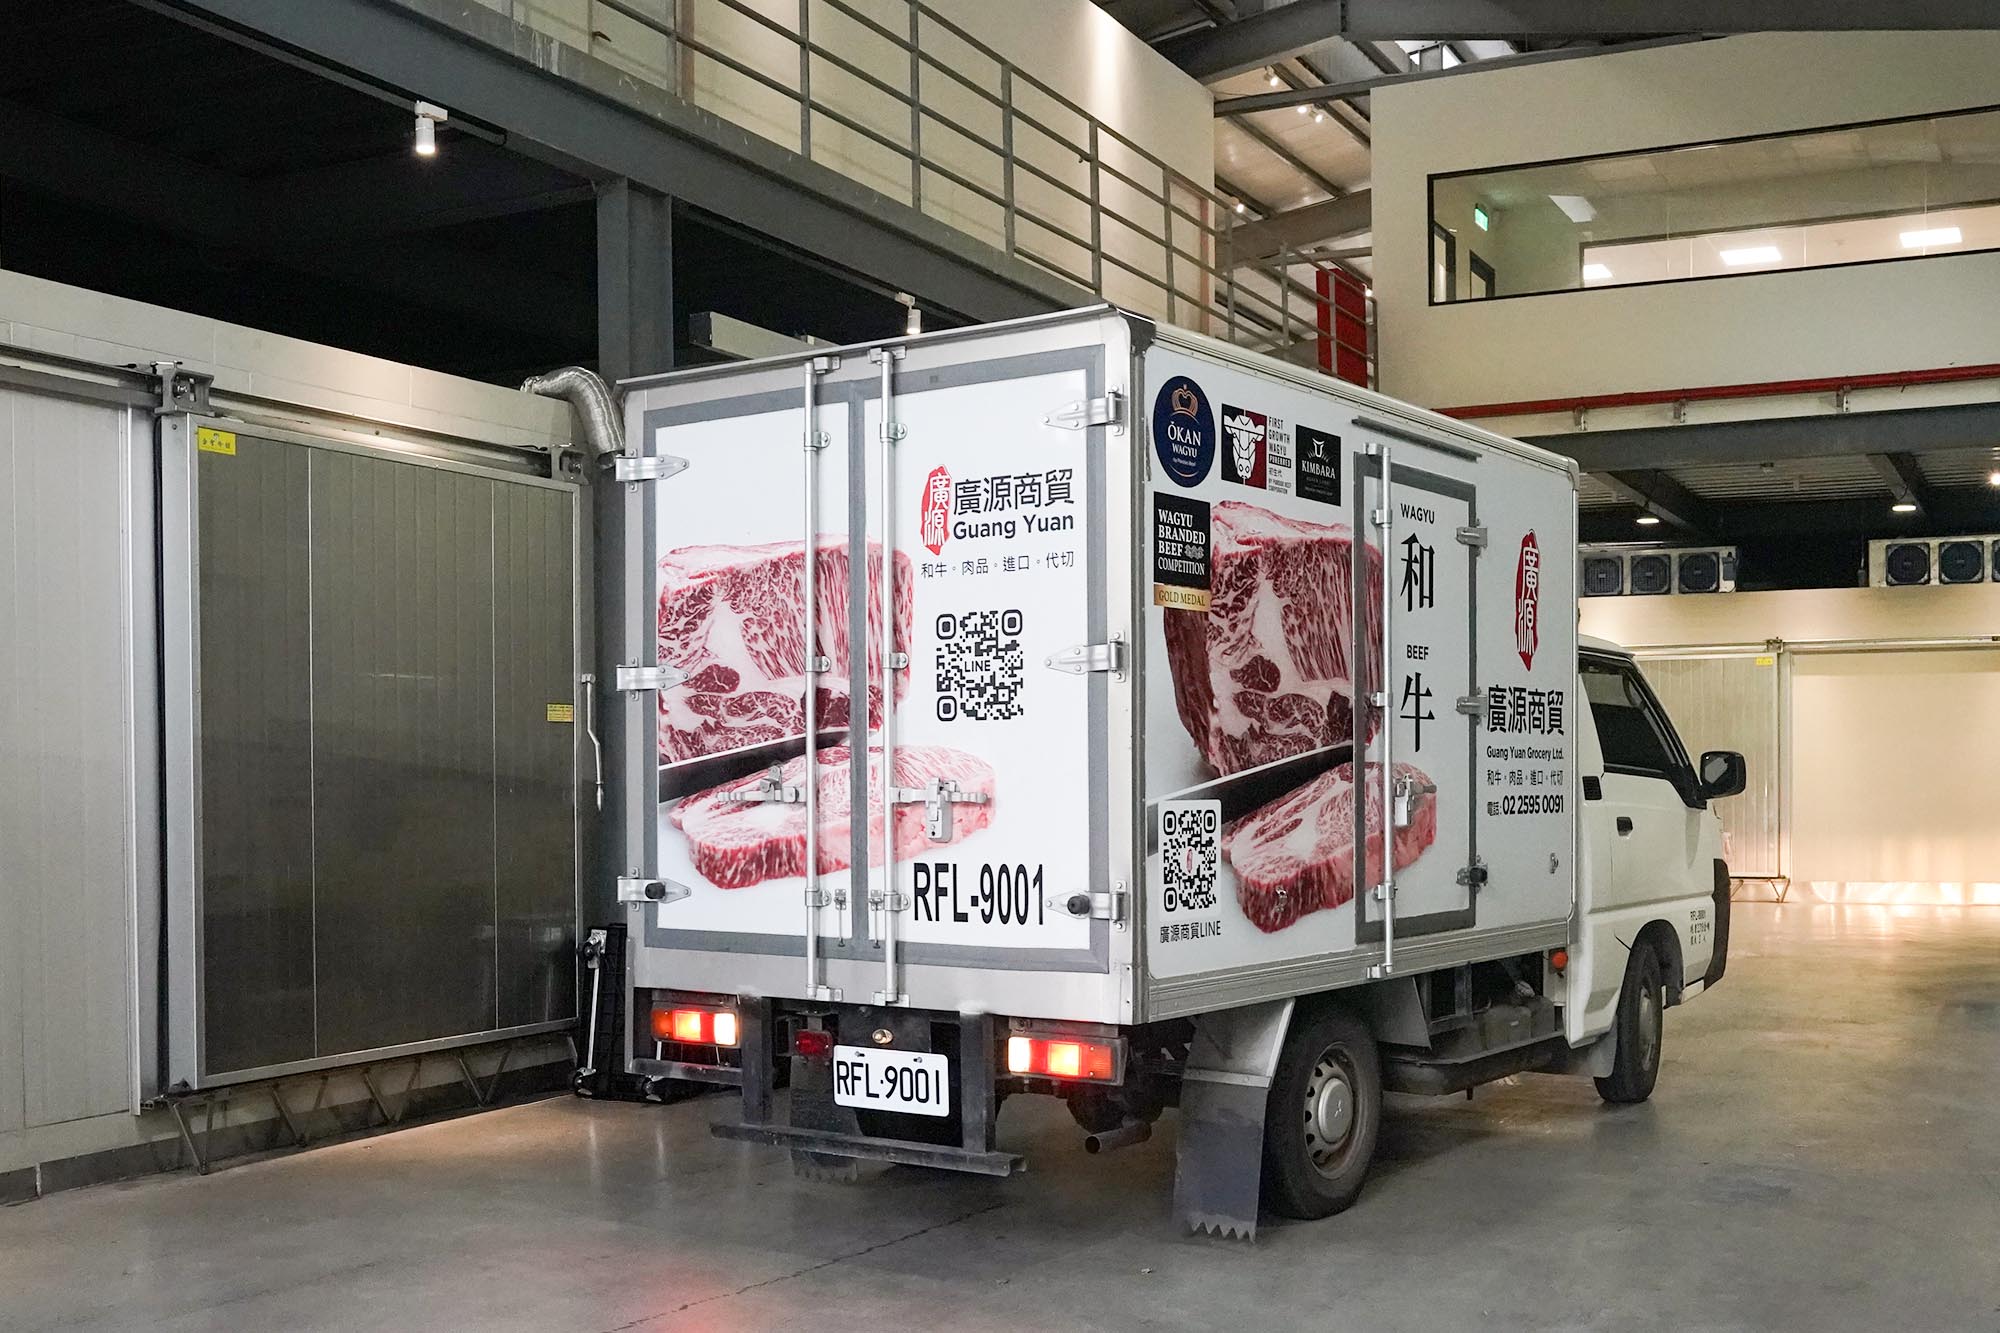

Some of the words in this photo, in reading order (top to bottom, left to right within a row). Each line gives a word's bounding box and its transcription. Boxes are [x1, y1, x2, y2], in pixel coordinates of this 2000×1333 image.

[1269, 416, 1283, 430] FIRST
[1172, 443, 1197, 458] WAGYU
[1269, 442, 1287, 456] WAGYU
[1301, 460, 1336, 479] KIMBARA
[953, 468, 1075, 516] 廣源商貿
[1158, 508, 1193, 528] WAGYU
[1400, 503, 1435, 524] WAGYU
[953, 519, 1016, 539] Guang
[1022, 514, 1074, 533] Yuan
[1158, 524, 1205, 545] BRANDED
[1158, 540, 1183, 557] BEEF
[1158, 556, 1205, 576] COMPETITION
[1400, 532, 1435, 612] 和
[1159, 591, 1179, 603] GOLD
[1180, 593, 1205, 606] MEDAL
[1406, 644, 1429, 661] BEEF
[964, 660, 991, 673] LINE
[1400, 671, 1435, 753] 牛
[1487, 684, 1565, 736] 廣源商貿
[1486, 745, 1508, 761] Guang
[1509, 746, 1526, 759] Yuan
[1527, 747, 1551, 762] Grocery
[1502, 795, 1516, 815] 02
[1517, 795, 1540, 814] 2595
[1542, 794, 1564, 814] 0091
[913, 862, 1044, 926] RFL-9001
